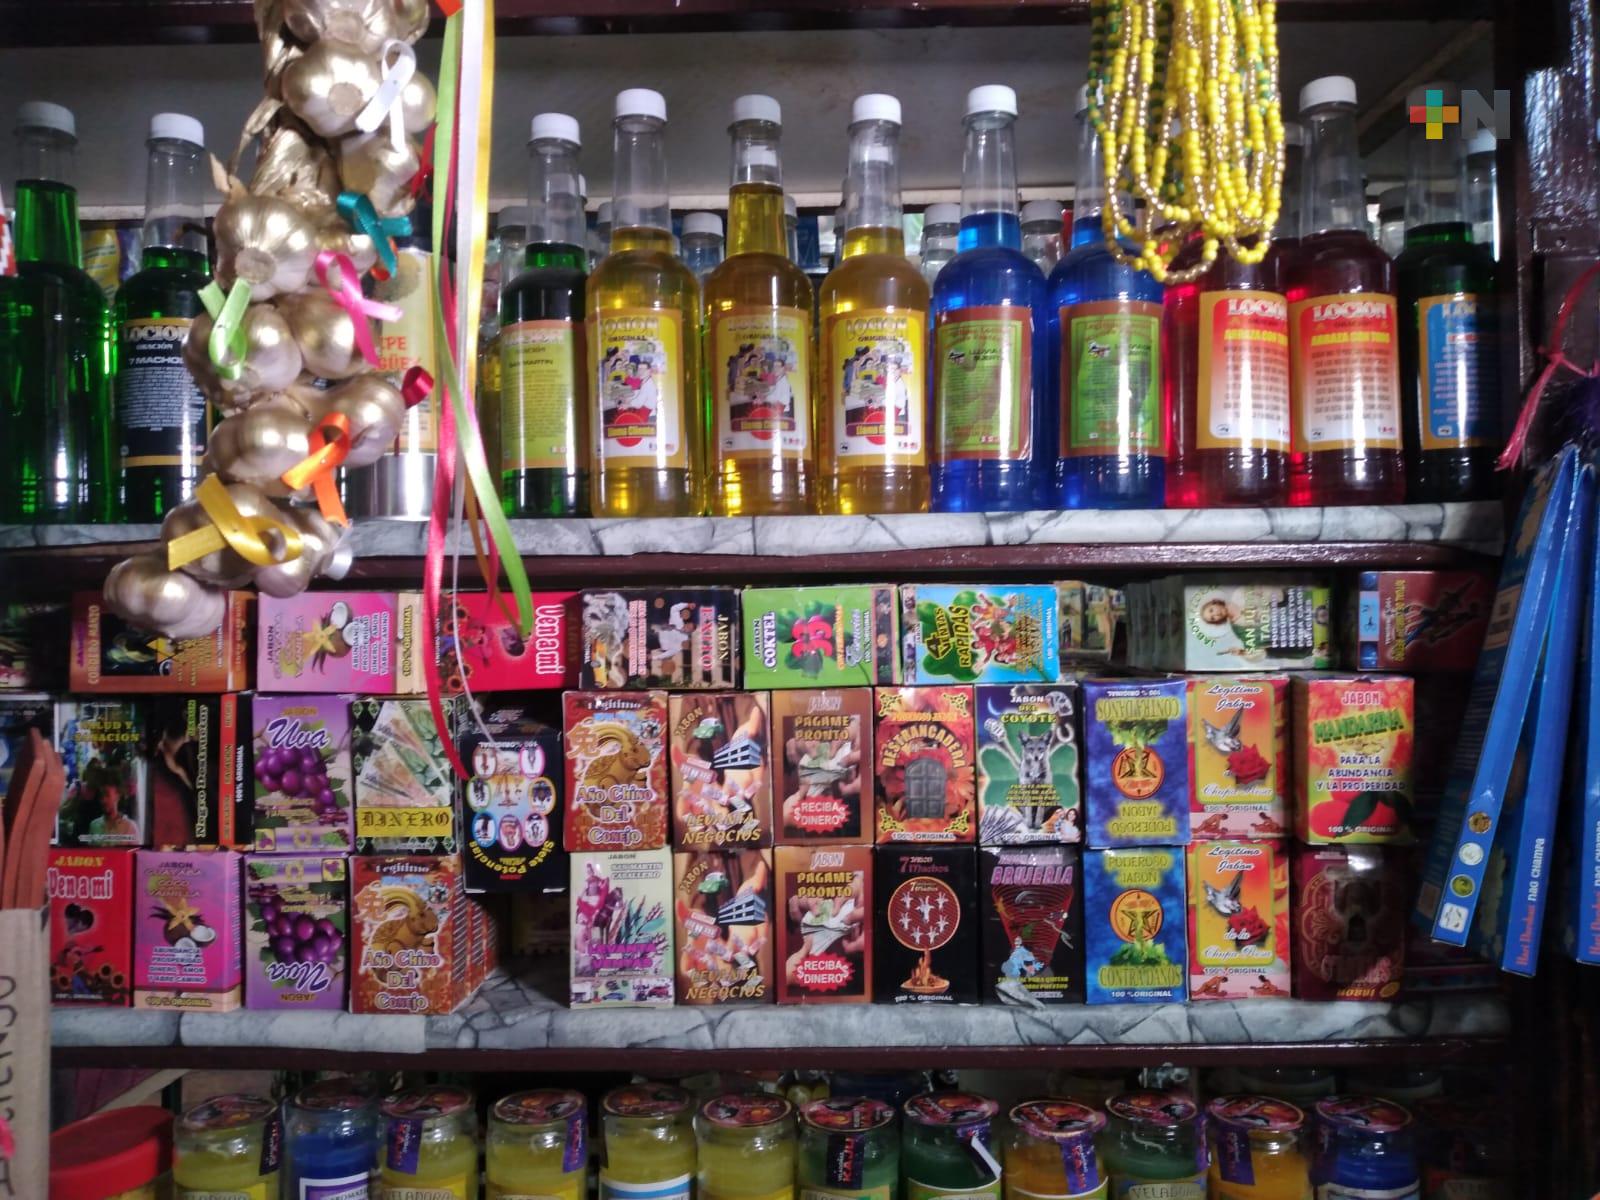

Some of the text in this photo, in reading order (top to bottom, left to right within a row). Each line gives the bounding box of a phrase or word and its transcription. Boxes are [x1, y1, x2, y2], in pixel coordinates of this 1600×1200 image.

[1313, 302, 1388, 321] LOCION
[370, 614, 378, 639] AMOR
[1287, 589, 1295, 649] PROTECTOR
[379, 612, 388, 646] CAMINO
[402, 607, 411, 651] ORIGINAL
[718, 612, 730, 659] JABON
[934, 608, 951, 659] VENTAS
[1187, 618, 1215, 650] JABON
[361, 617, 369, 673] PROSPERIDAD
[752, 620, 761, 659] JABON
[762, 613, 776, 669] COKTEL
[947, 606, 971, 669] RAPIDAS
[1244, 628, 1255, 656] SAN
[1010, 695, 1043, 703] JABON
[1341, 691, 1382, 706] JABON
[674, 706, 704, 737] JABON
[795, 715, 850, 727] PAGAME
[1000, 714, 1057, 724] COYOTE
[1314, 708, 1404, 744] MANDARINA
[267, 717, 331, 749] Uva
[795, 729, 849, 741] PRONTO
[235, 746, 244, 783] ORIGINAL
[1340, 755, 1382, 764] PARA LA
[1328, 768, 1393, 777] ABUNDANCIA
[1317, 781, 1407, 791] Y LA PROSPERIDAD
[801, 802, 837, 812] RECIBA
[1124, 806, 1160, 817] JABON
[1228, 804, 1269, 812] ORIGINAL
[362, 811, 450, 828] DINERO
[801, 815, 839, 825] DINERO
[1113, 821, 1173, 833] PODEROSO
[682, 828, 763, 846] NEGOCIOS
[914, 832, 956, 840] ORIGINAL
[55, 856, 104, 867] JABON
[469, 840, 556, 875] Siete Potencias
[899, 856, 910, 873] 7
[1108, 856, 1168, 868] PODEROSO
[679, 861, 709, 893] JABON
[797, 871, 854, 883] PAGAME
[990, 865, 1074, 885] BRUJERIA
[1122, 872, 1158, 883] JABON
[797, 885, 853, 898] PRONTO
[1203, 946, 1240, 961] Chupa
[183, 966, 205, 974] AMOR
[804, 959, 841, 970] RECIBA
[176, 975, 206, 983] CAMINO
[267, 960, 330, 992] Uva
[804, 972, 843, 984] DINERO
[280, 993, 315, 1001] JABON
[685, 984, 766, 1001] NEGOCIOS
